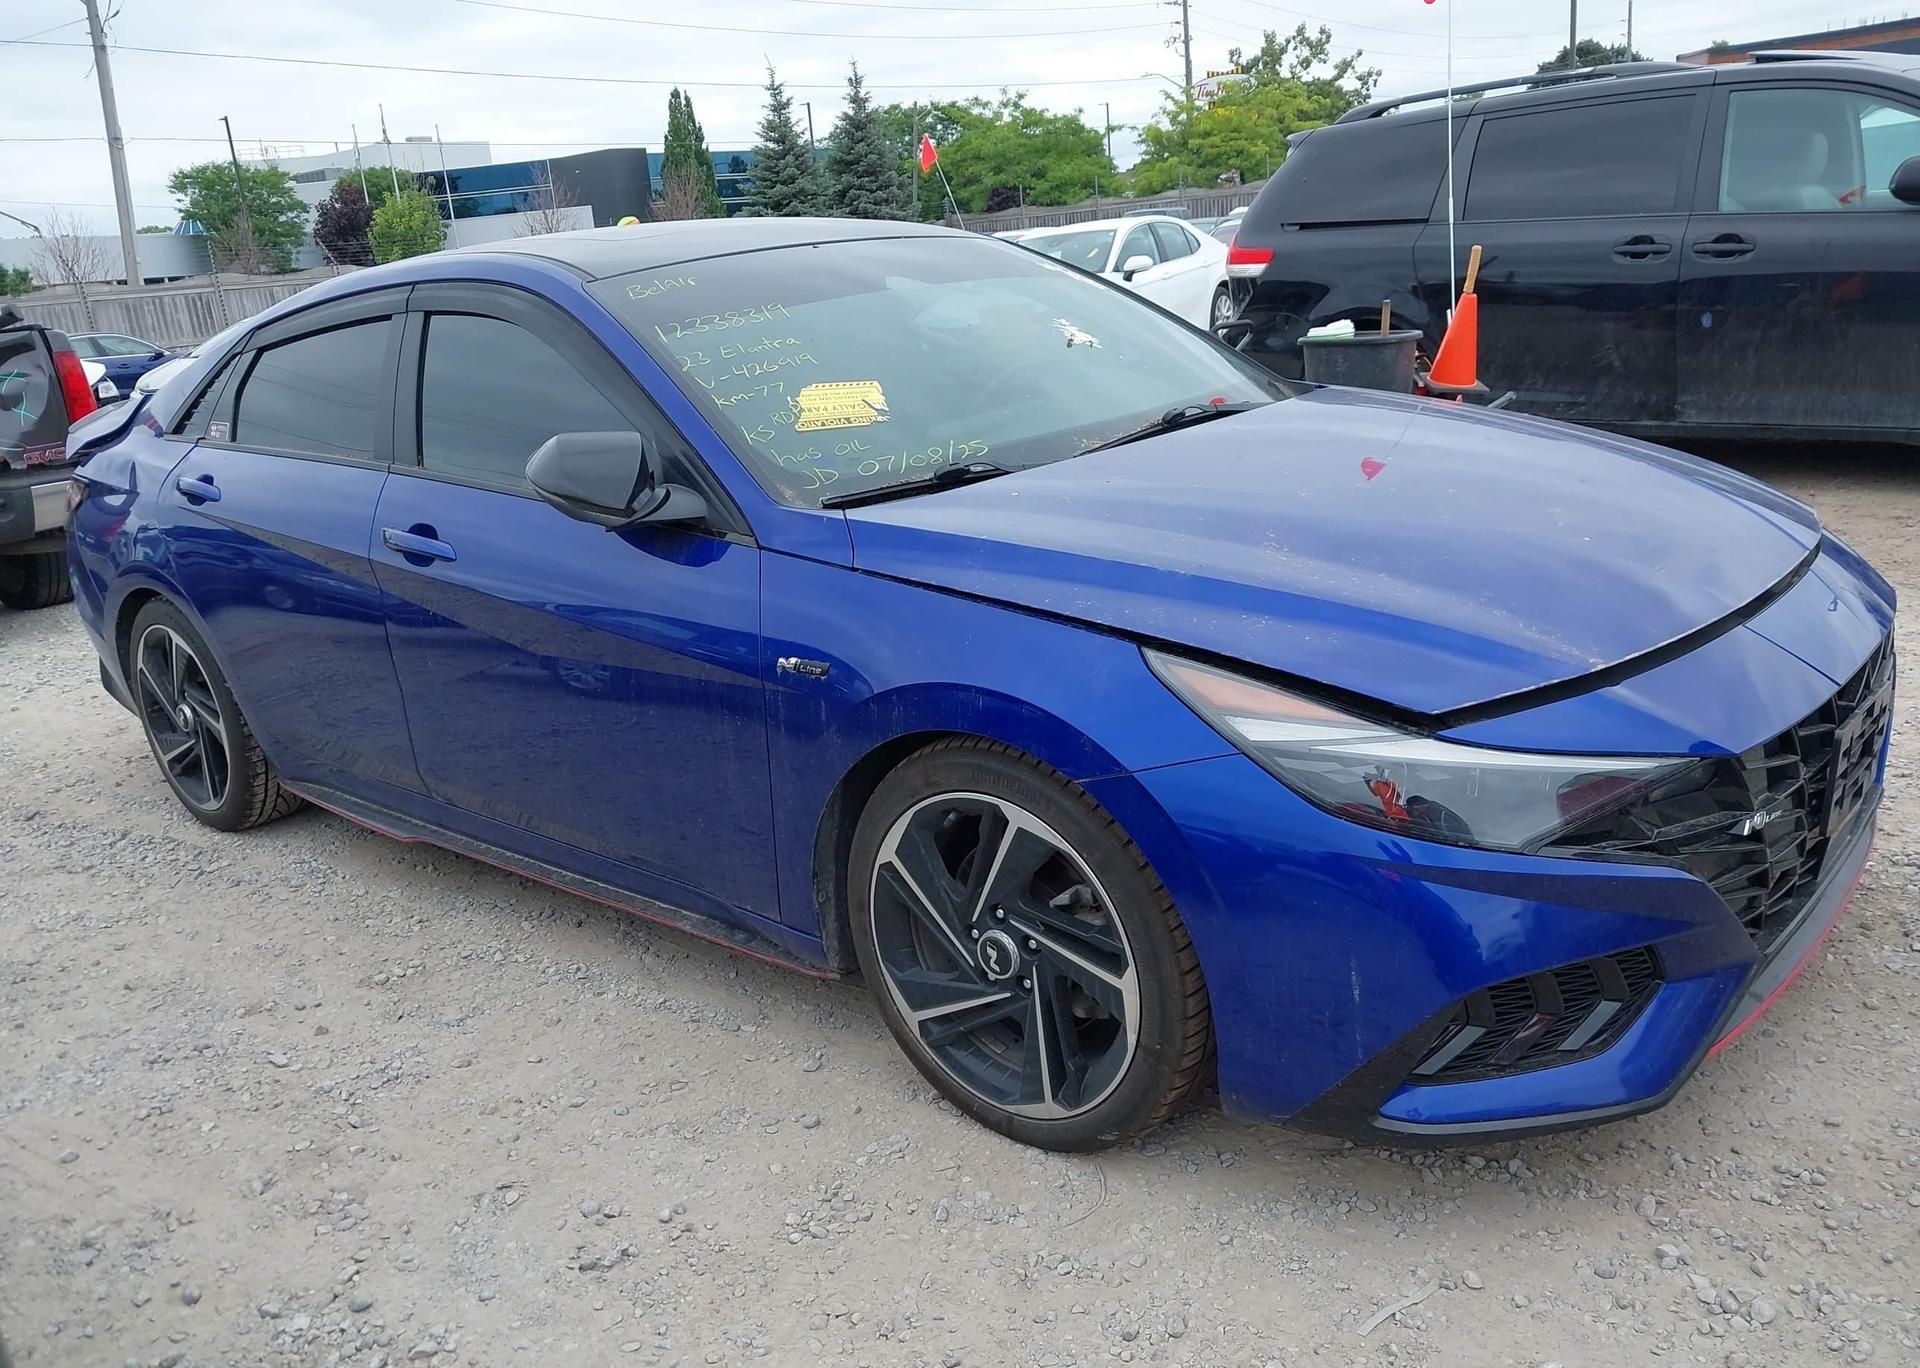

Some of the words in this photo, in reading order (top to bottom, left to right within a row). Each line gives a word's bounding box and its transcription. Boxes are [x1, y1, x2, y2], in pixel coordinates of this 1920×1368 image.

[654, 302, 791, 344] 12338319
[675, 351, 711, 373] 23
[719, 336, 802, 359] Elantra
[795, 417, 847, 429] VIOLATIO
[24, 447, 66, 464] GMC
